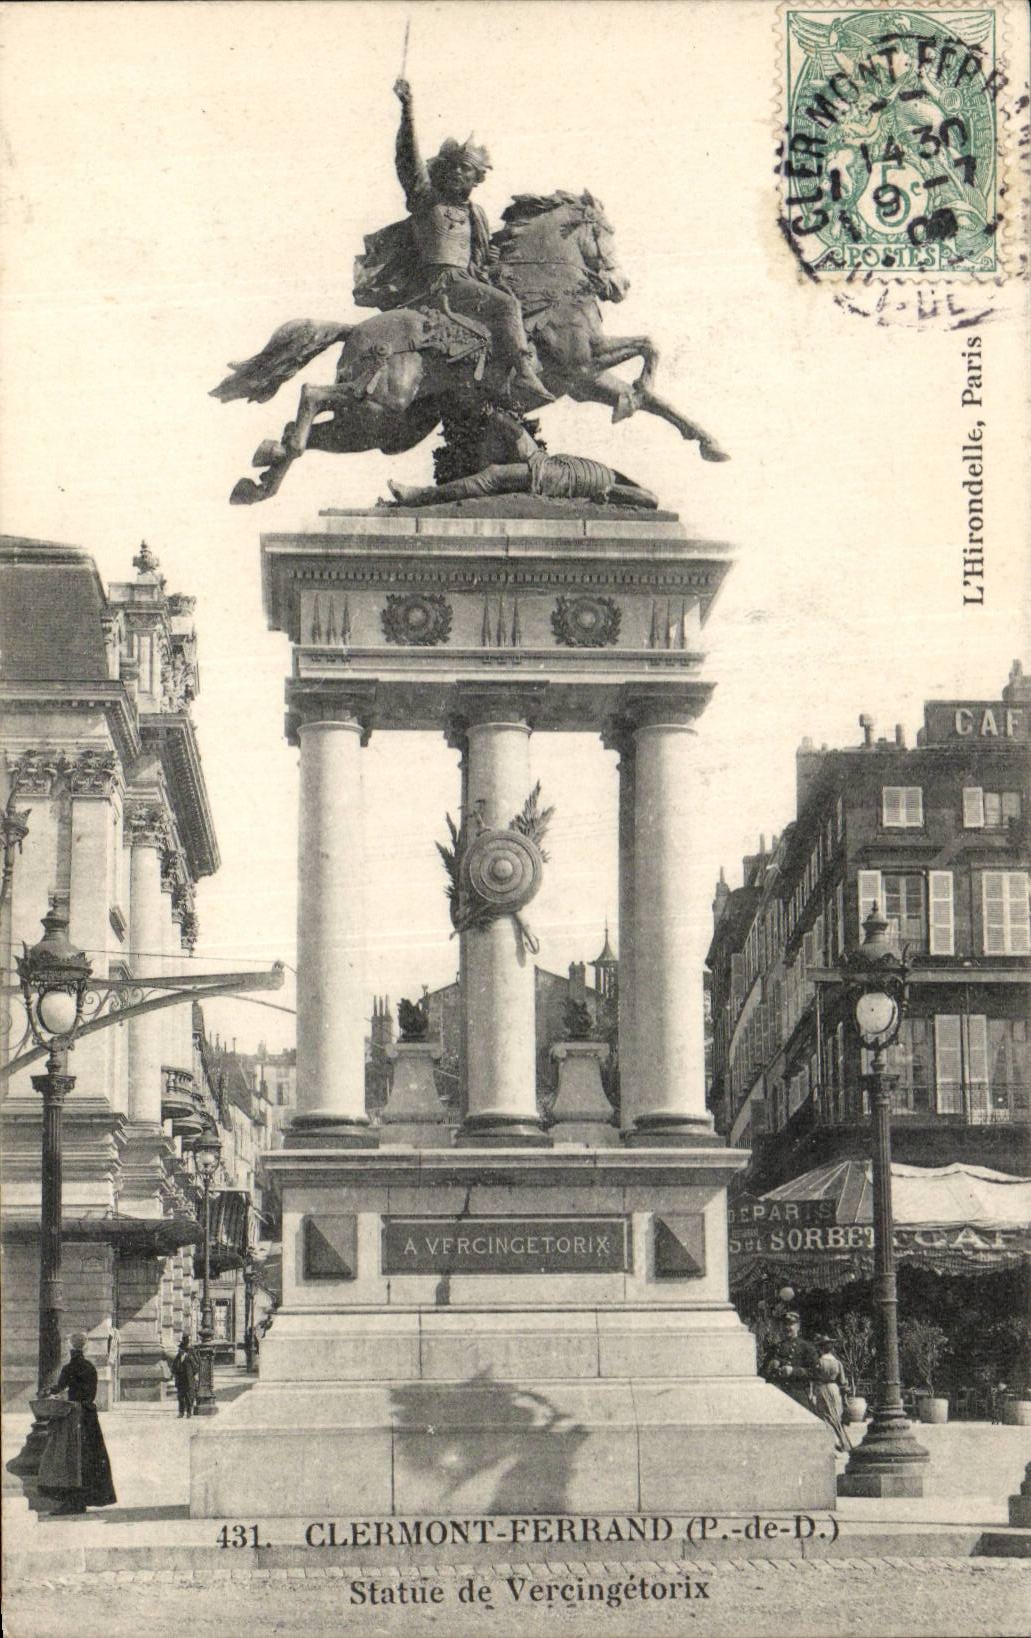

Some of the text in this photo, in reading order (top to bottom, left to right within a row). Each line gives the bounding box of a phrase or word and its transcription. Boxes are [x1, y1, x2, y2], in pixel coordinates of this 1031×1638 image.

[847, 246, 936, 268] POSTES
[403, 1236, 611, 1256] A VERCINGETORIX
